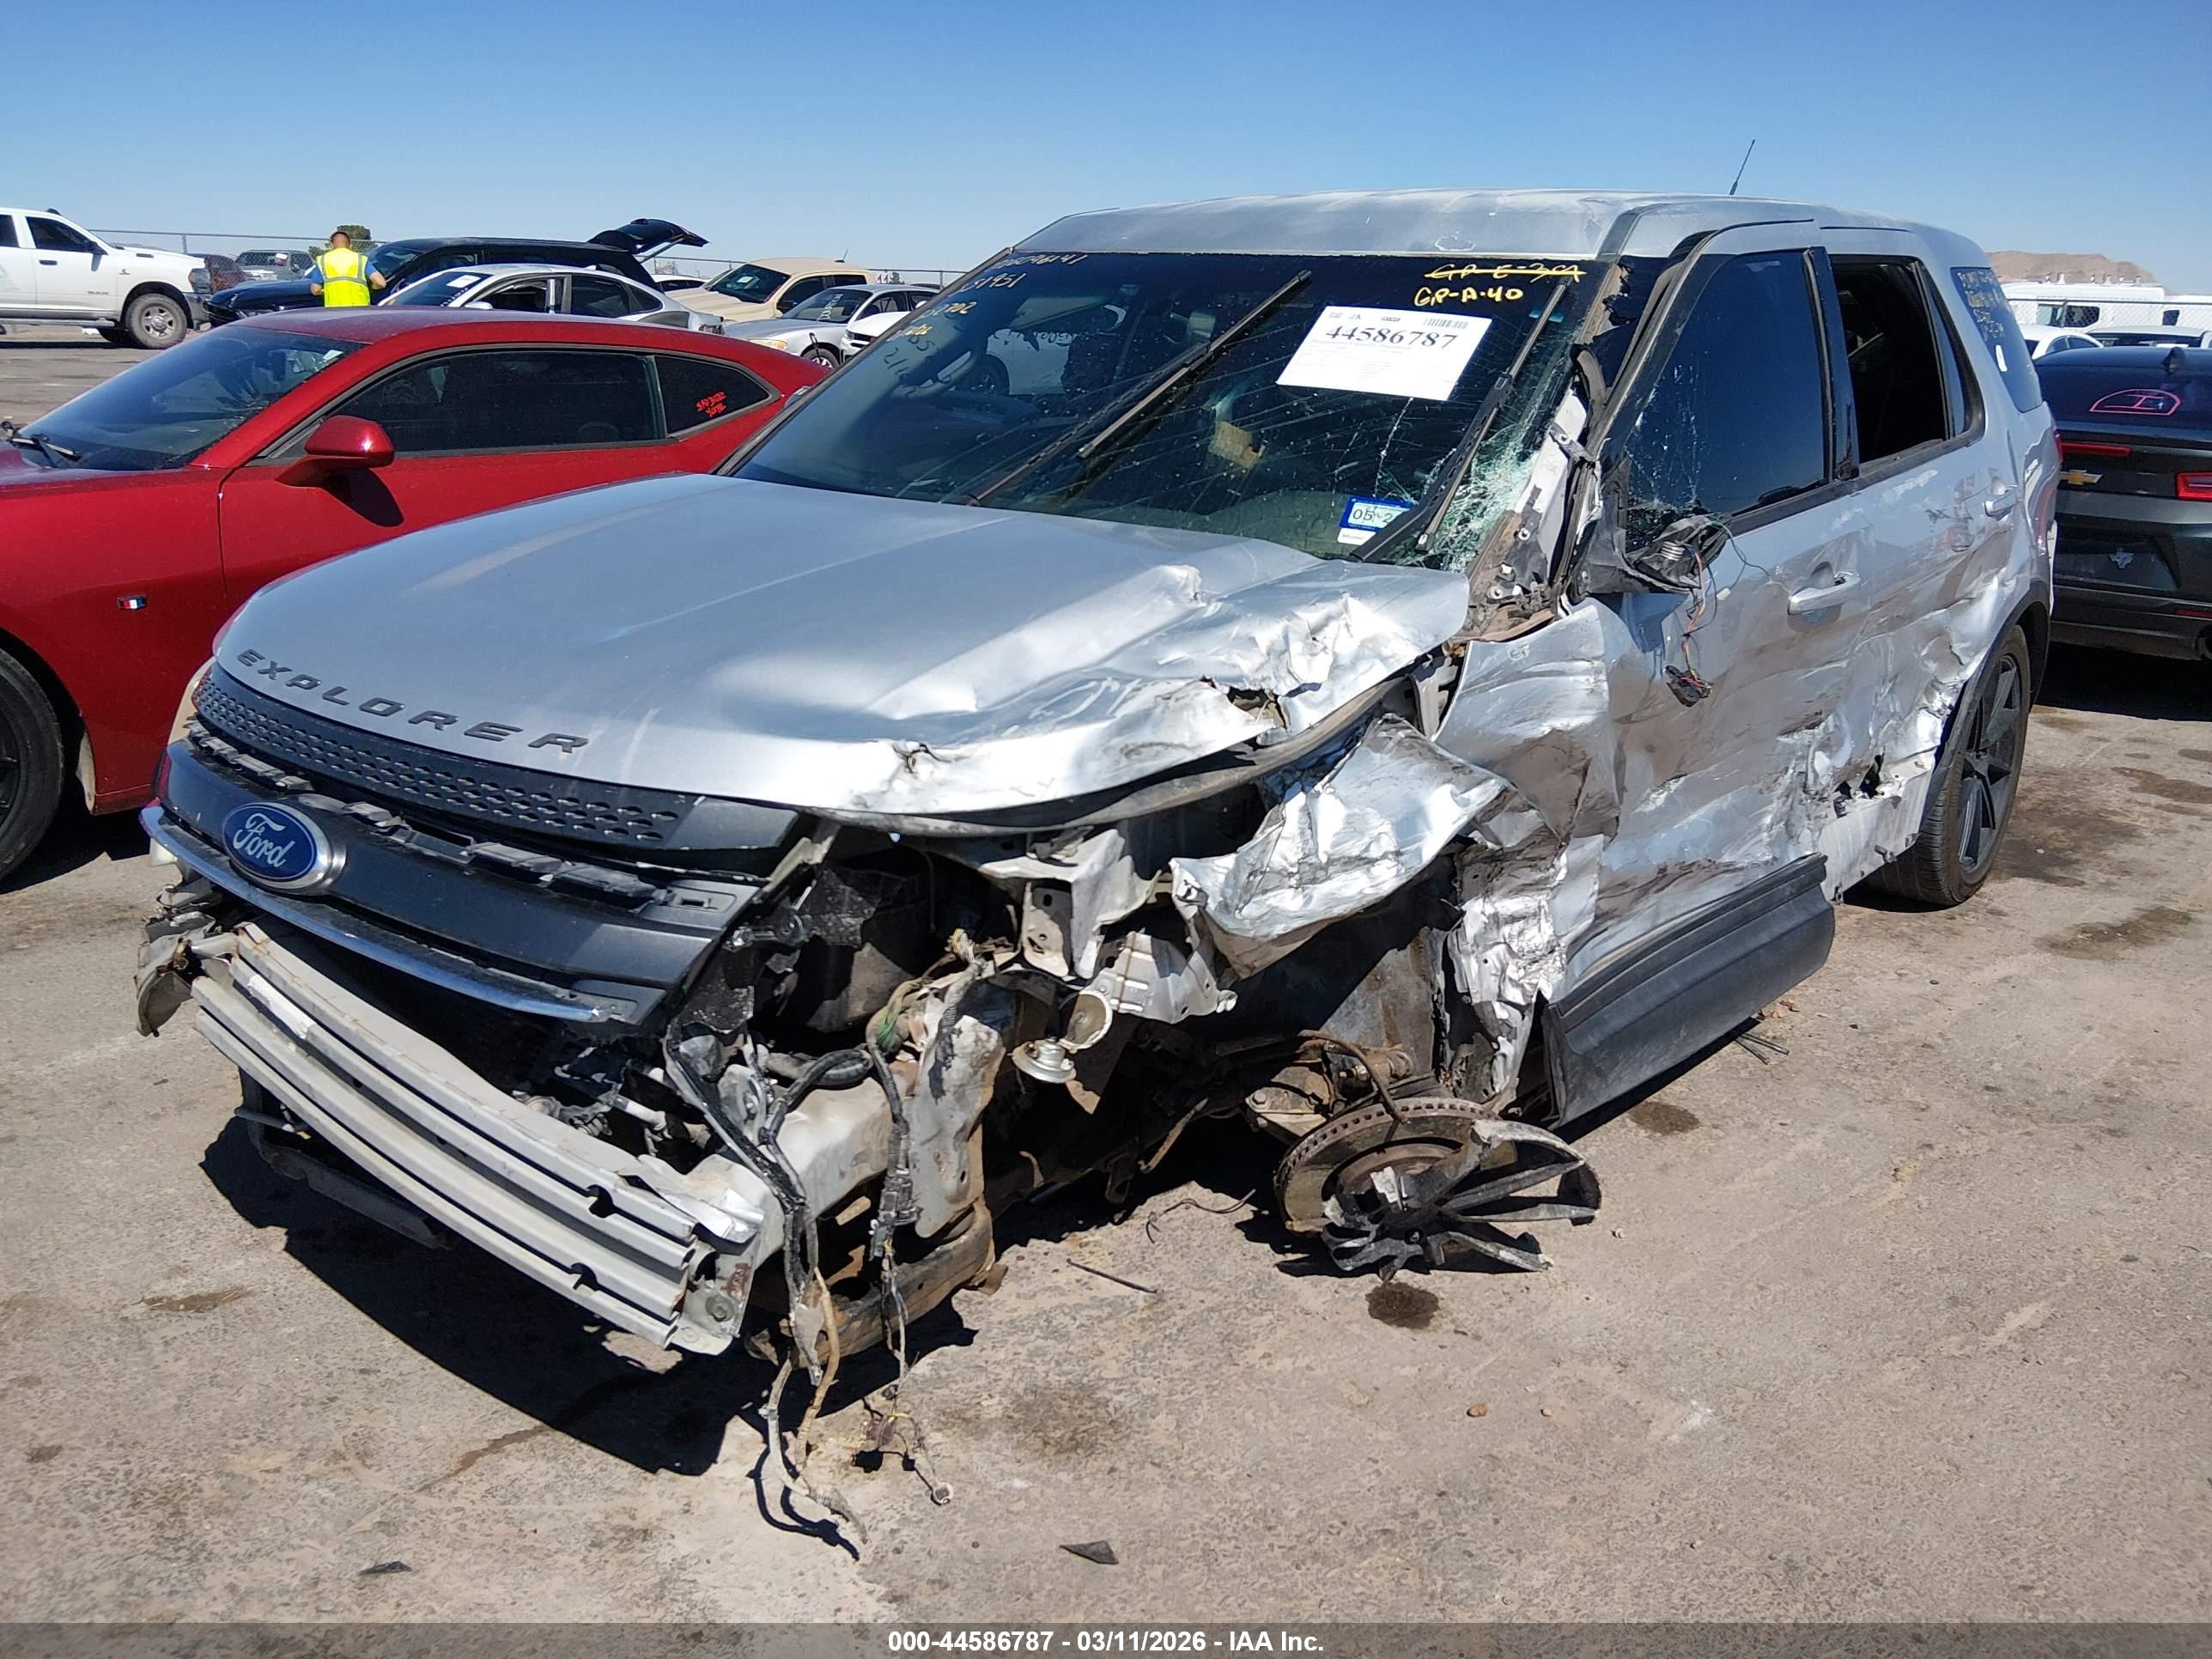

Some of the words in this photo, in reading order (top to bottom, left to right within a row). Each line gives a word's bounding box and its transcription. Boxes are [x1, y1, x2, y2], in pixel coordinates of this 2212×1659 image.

[1326, 325, 1458, 349] 44586787
[237, 648, 590, 754] EXPLORER
[233, 812, 296, 867] Ford
